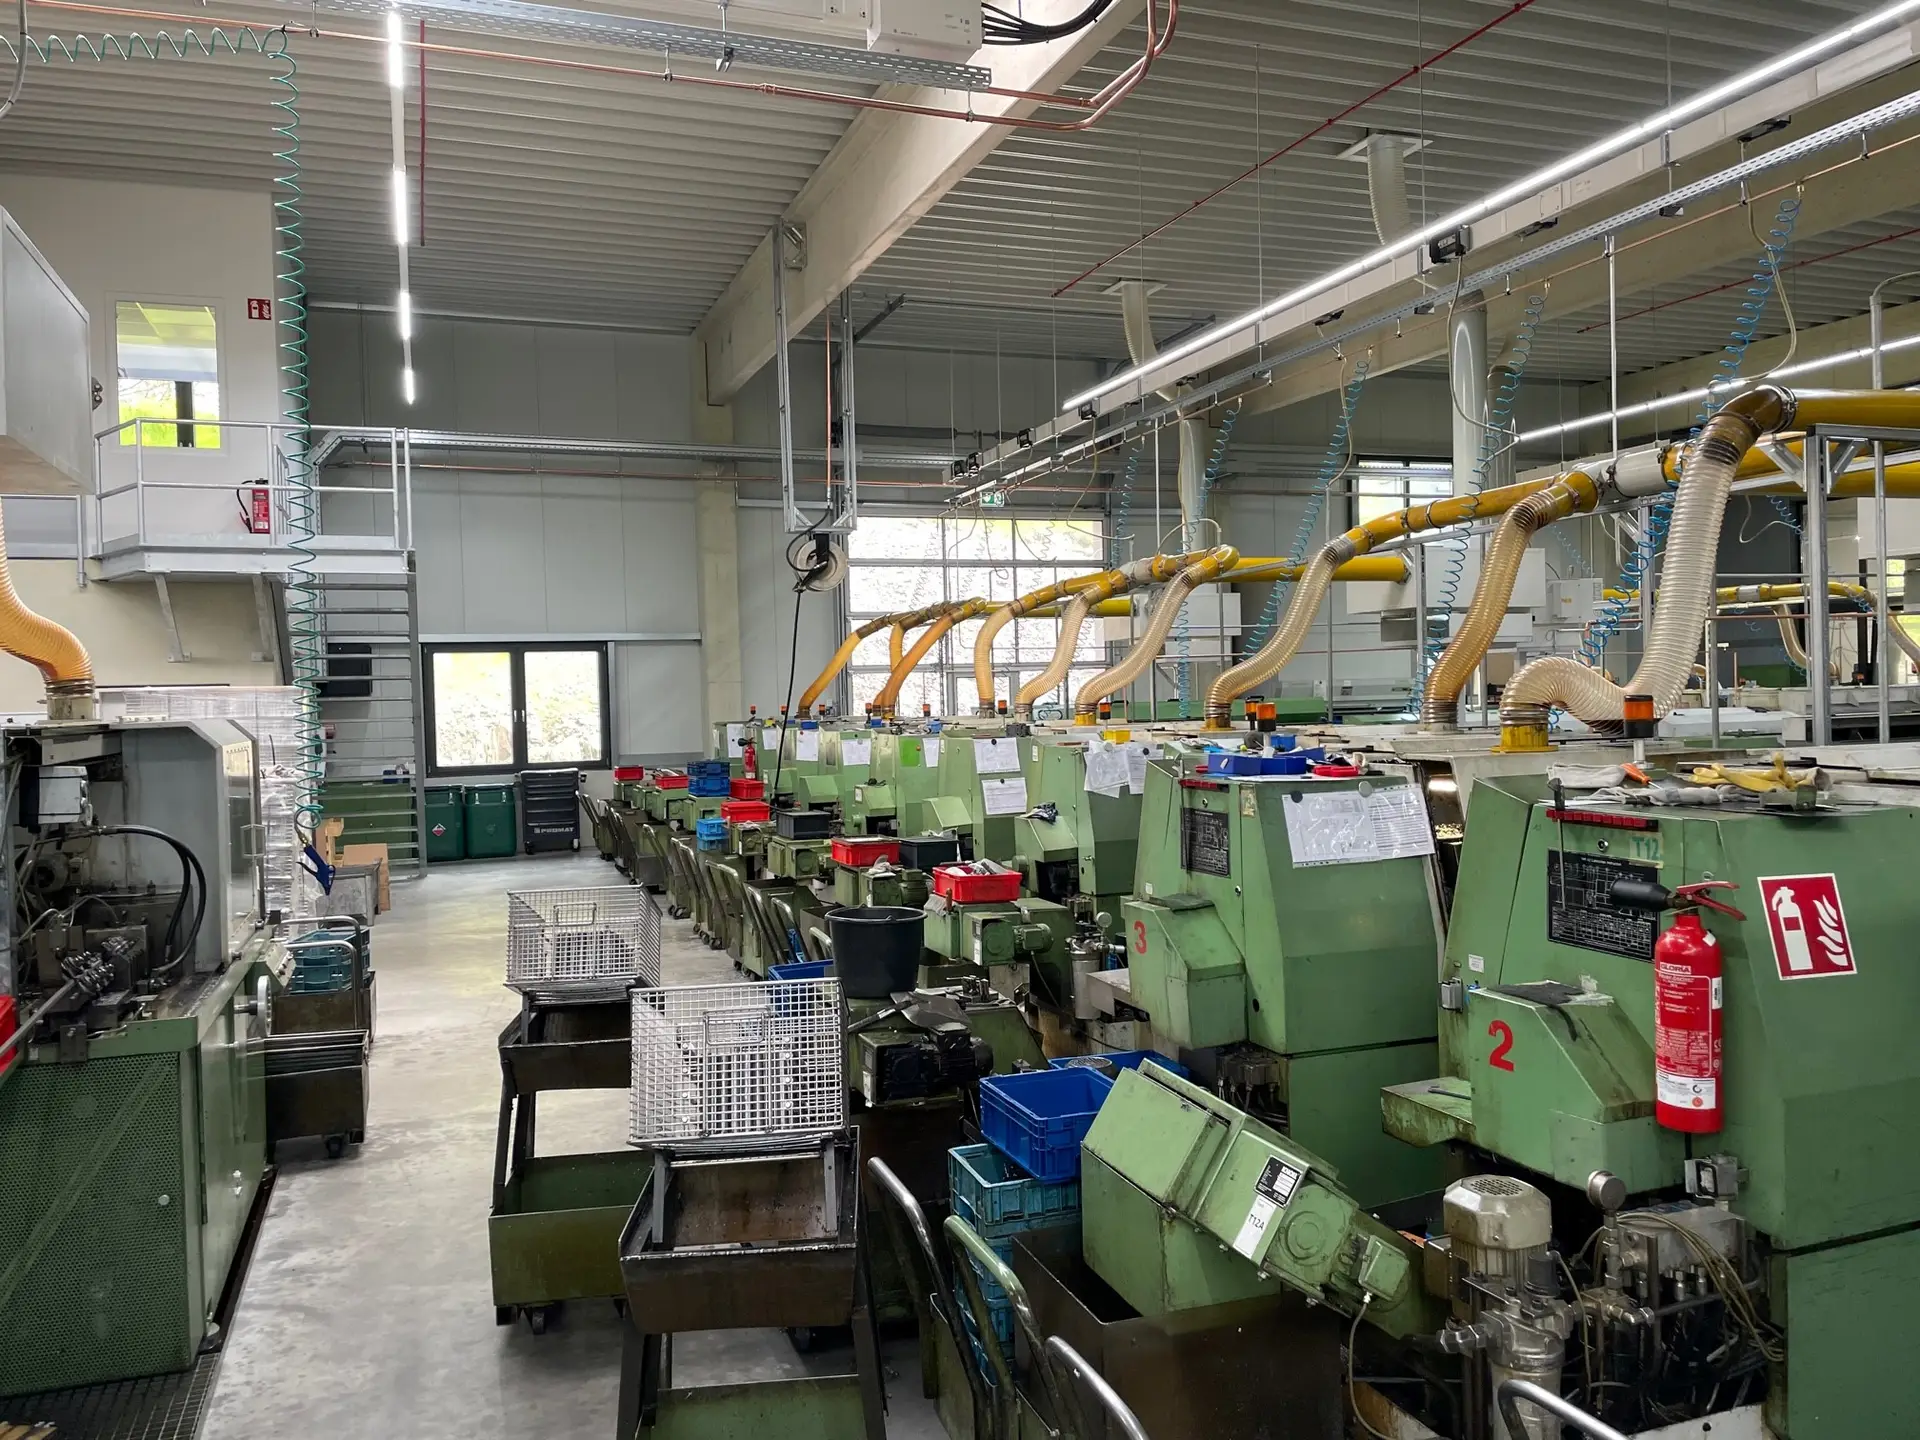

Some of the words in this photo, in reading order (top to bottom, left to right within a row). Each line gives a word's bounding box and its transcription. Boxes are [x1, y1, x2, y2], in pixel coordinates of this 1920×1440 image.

[1632, 837, 1660, 860] T12
[1134, 920, 1147, 955] 3
[1660, 963, 1690, 973] GLORIA
[1488, 1019, 1515, 1072] 2
[1248, 1214, 1265, 1231] T12A
